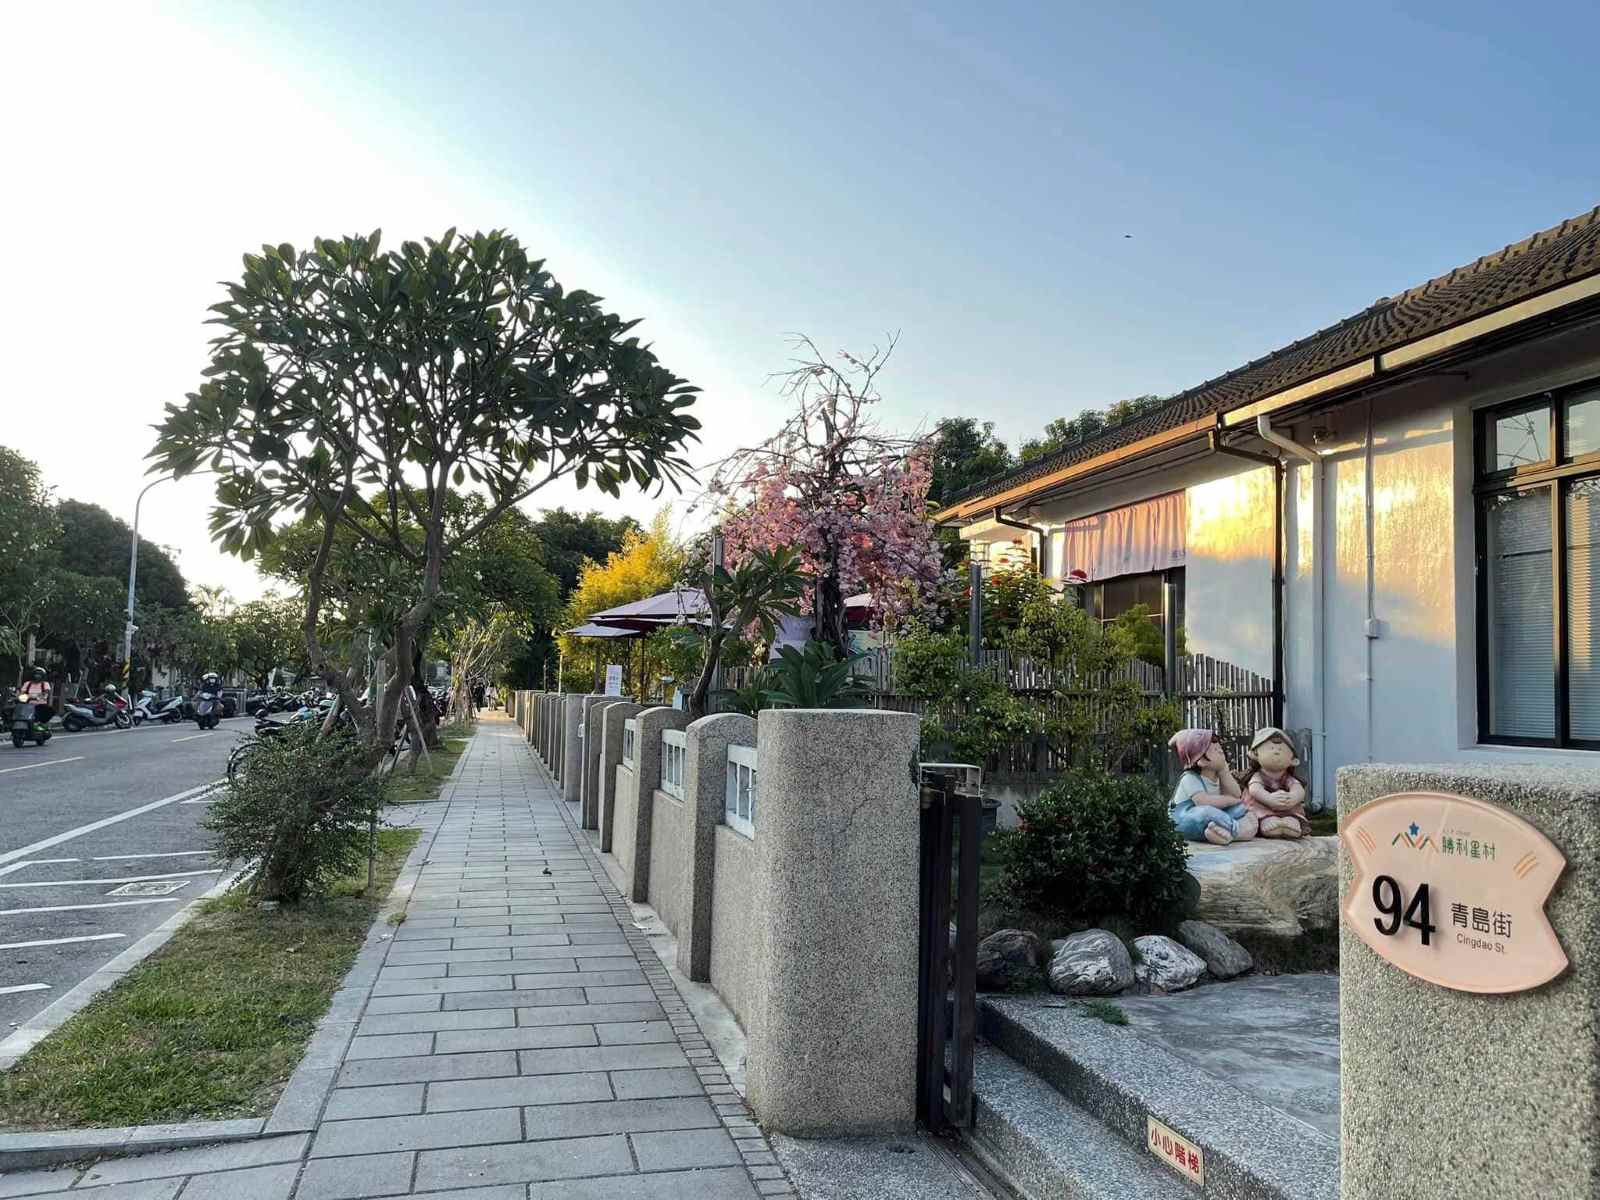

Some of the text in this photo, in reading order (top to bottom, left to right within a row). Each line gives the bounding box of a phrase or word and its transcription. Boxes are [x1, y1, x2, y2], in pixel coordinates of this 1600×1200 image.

[1372, 875, 1436, 946] 94
[1451, 902, 1513, 938] 青島街
[1456, 932, 1493, 951] Cingdao
[1151, 1127, 1199, 1174] 小心階梯
